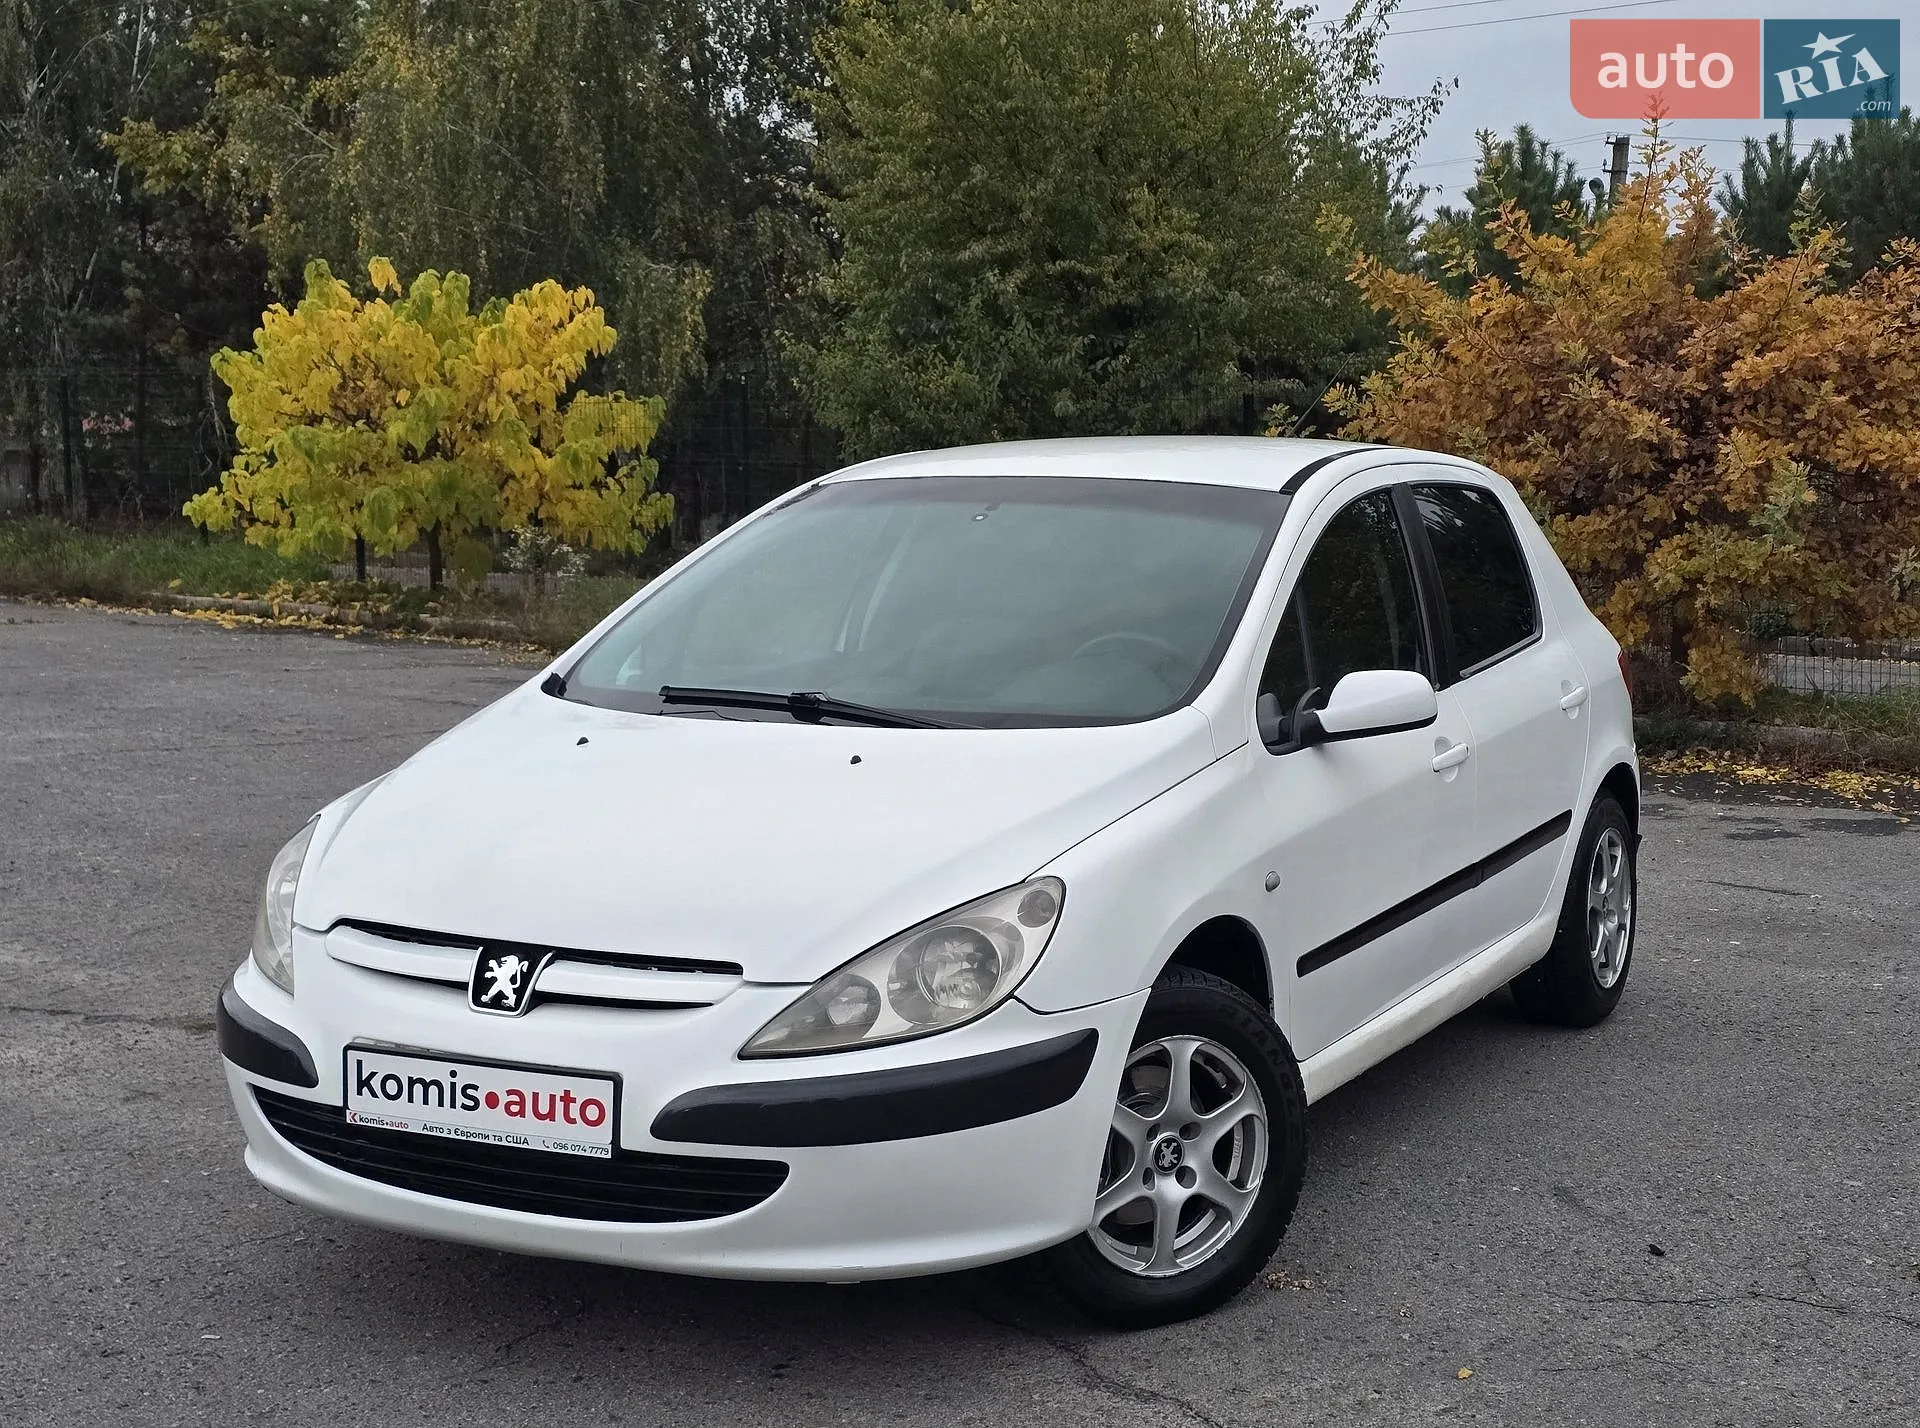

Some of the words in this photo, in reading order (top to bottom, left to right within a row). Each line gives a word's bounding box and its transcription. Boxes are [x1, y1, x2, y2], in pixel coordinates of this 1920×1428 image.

[421, 1123, 445, 1134] Авто
[454, 1128, 490, 1141] Європи
[492, 1134, 503, 1143] та
[505, 1134, 530, 1146] США
[552, 1142, 569, 1151] 096
[570, 1144, 588, 1153] 074
[588, 1146, 610, 1156] 7779
